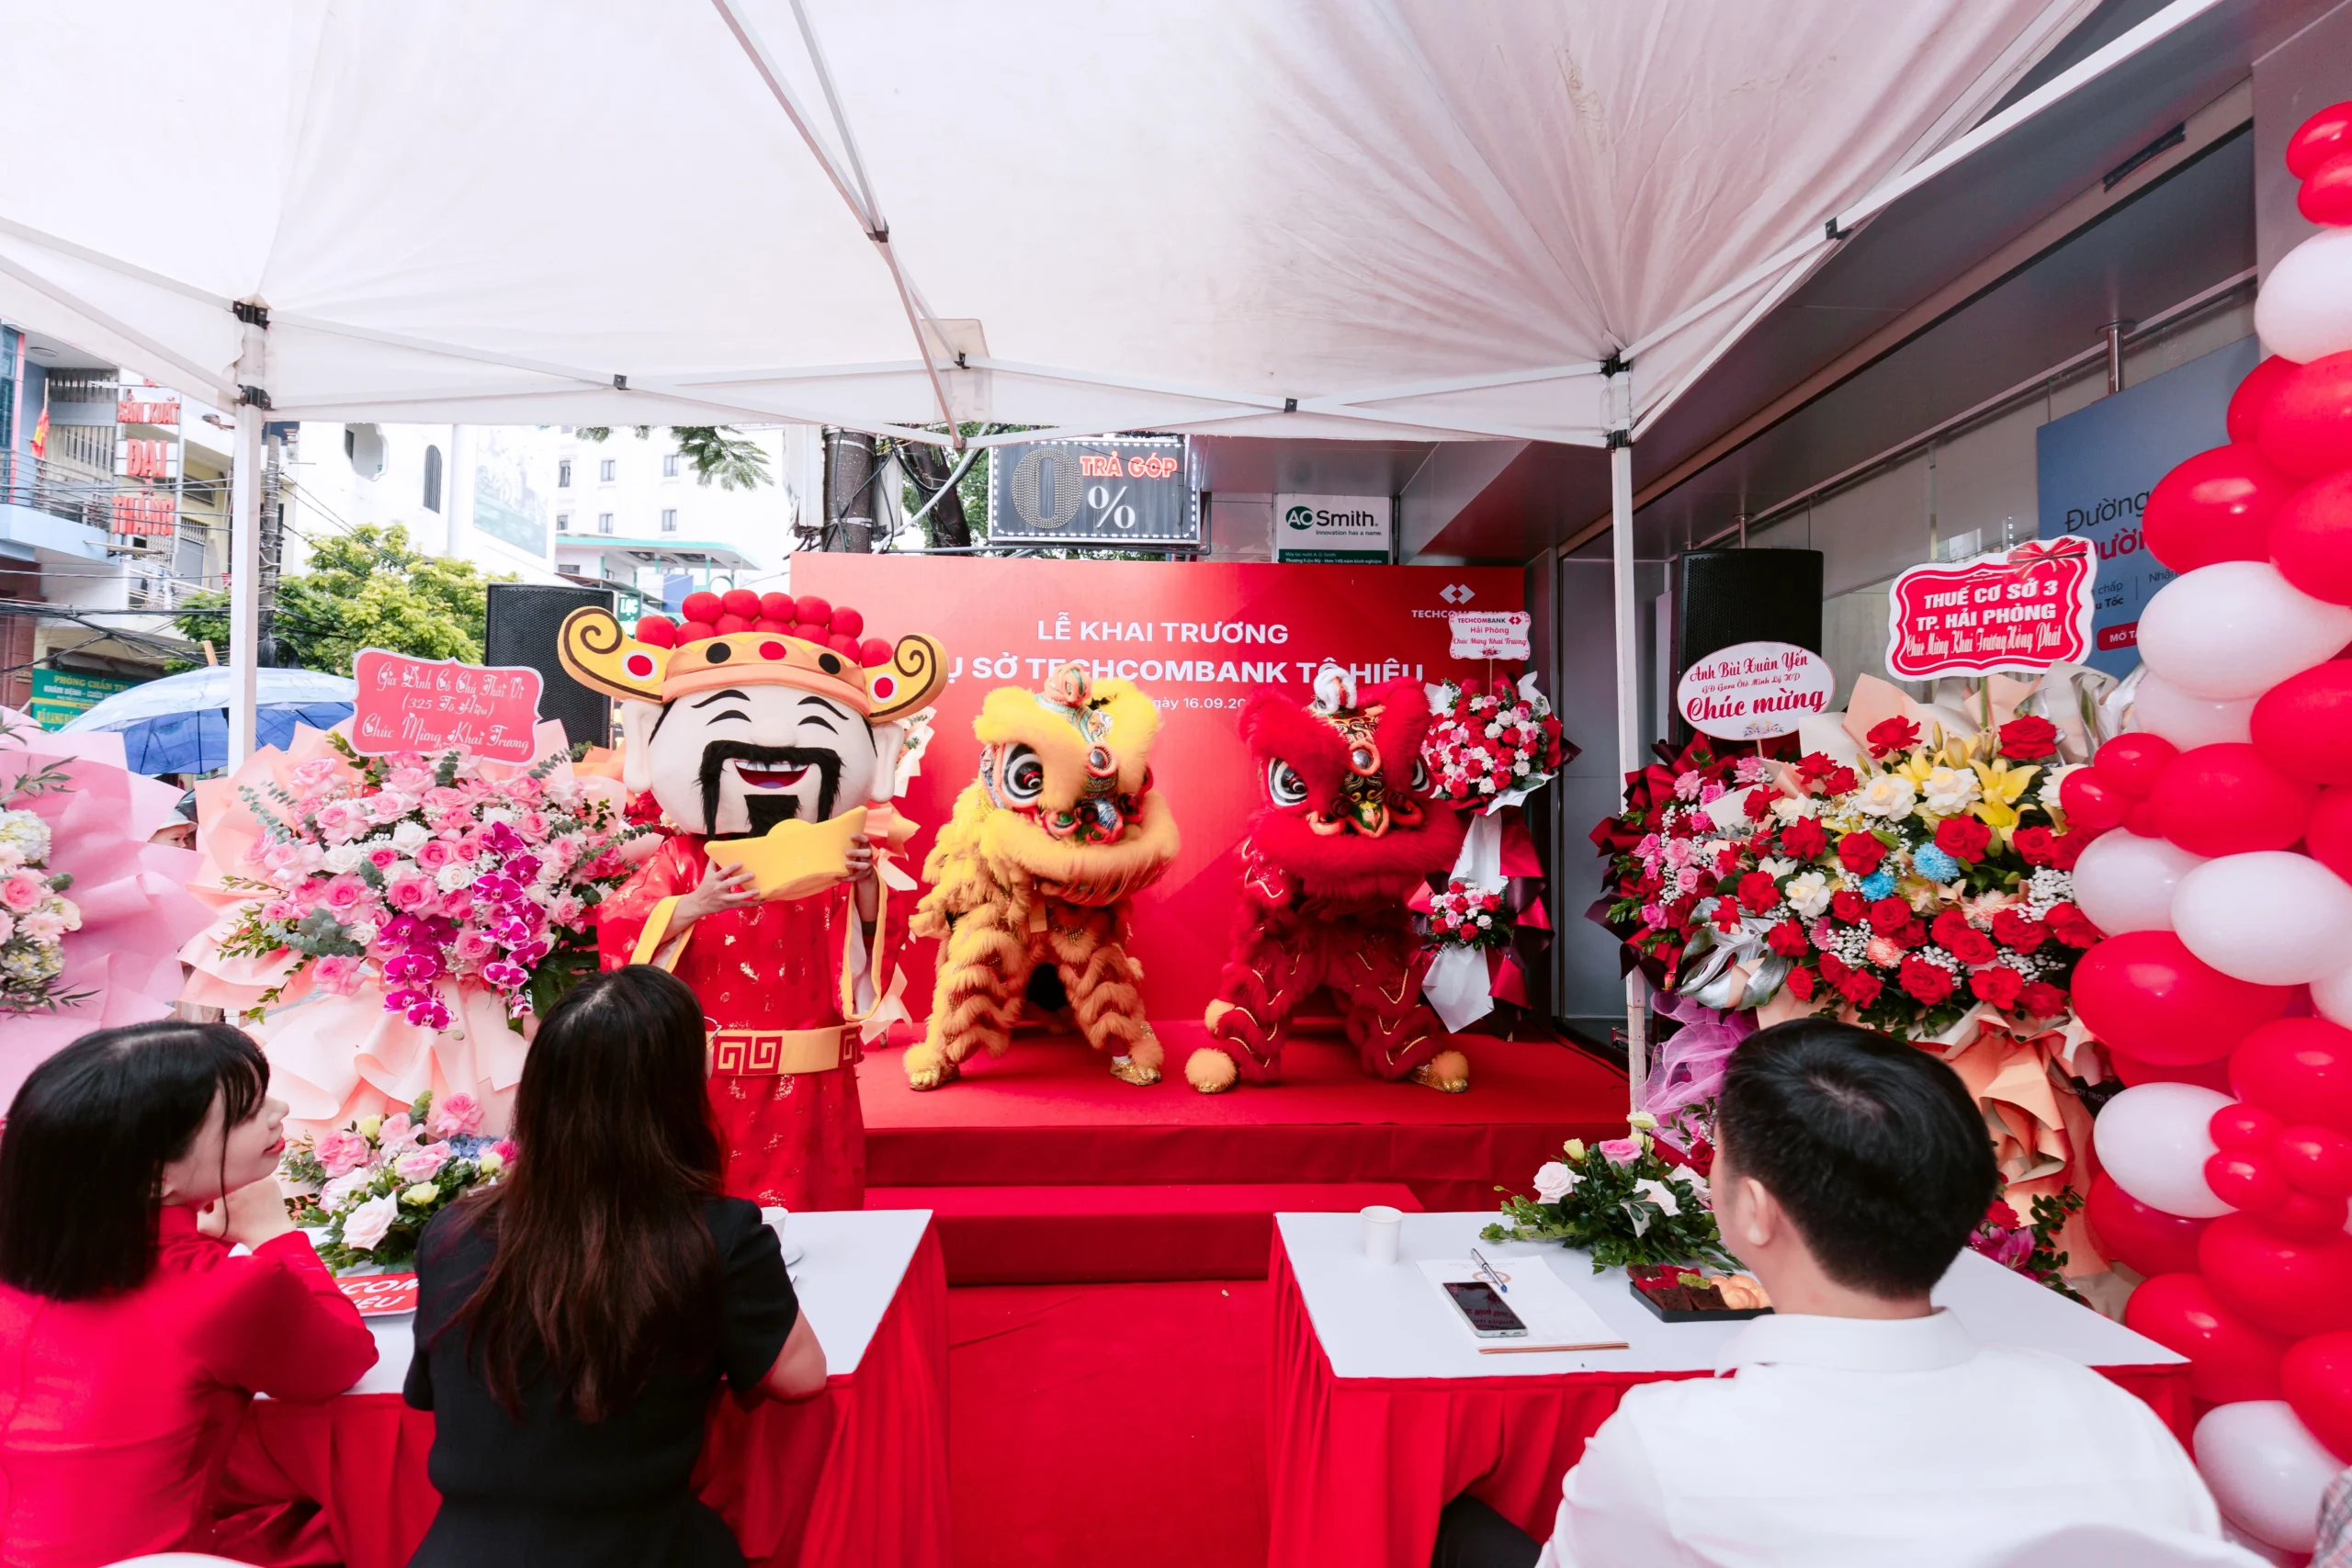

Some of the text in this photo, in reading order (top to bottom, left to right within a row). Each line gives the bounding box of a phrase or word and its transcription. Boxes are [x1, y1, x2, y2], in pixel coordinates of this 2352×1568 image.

[1080, 450, 1178, 479] TRẢ GÓP
[2064, 491, 2150, 533] Đường
[1924, 578, 2059, 610] THUẾ CƠ SỞ 3
[2098, 581, 2123, 595] chấp
[1038, 612, 1288, 644] LỄ KHAI TRƯƠNG
[1485, 626, 1510, 635] Phòng
[1916, 603, 2057, 632] TP. HẢI PHÒNG
[1951, 630, 1973, 654] Khai
[971, 651, 1018, 679] SỞ
[1690, 649, 1809, 682] Anh Bùi Xuân Yến
[436, 669, 451, 691] Cô
[456, 671, 477, 694] Chú
[402, 692, 433, 711] (325
[436, 695, 457, 711] Tô
[1152, 696, 1179, 710] gày
[1686, 688, 1826, 722] Chúc mừng
[362, 713, 394, 739] Chúc
[443, 721, 485, 746] Khai
